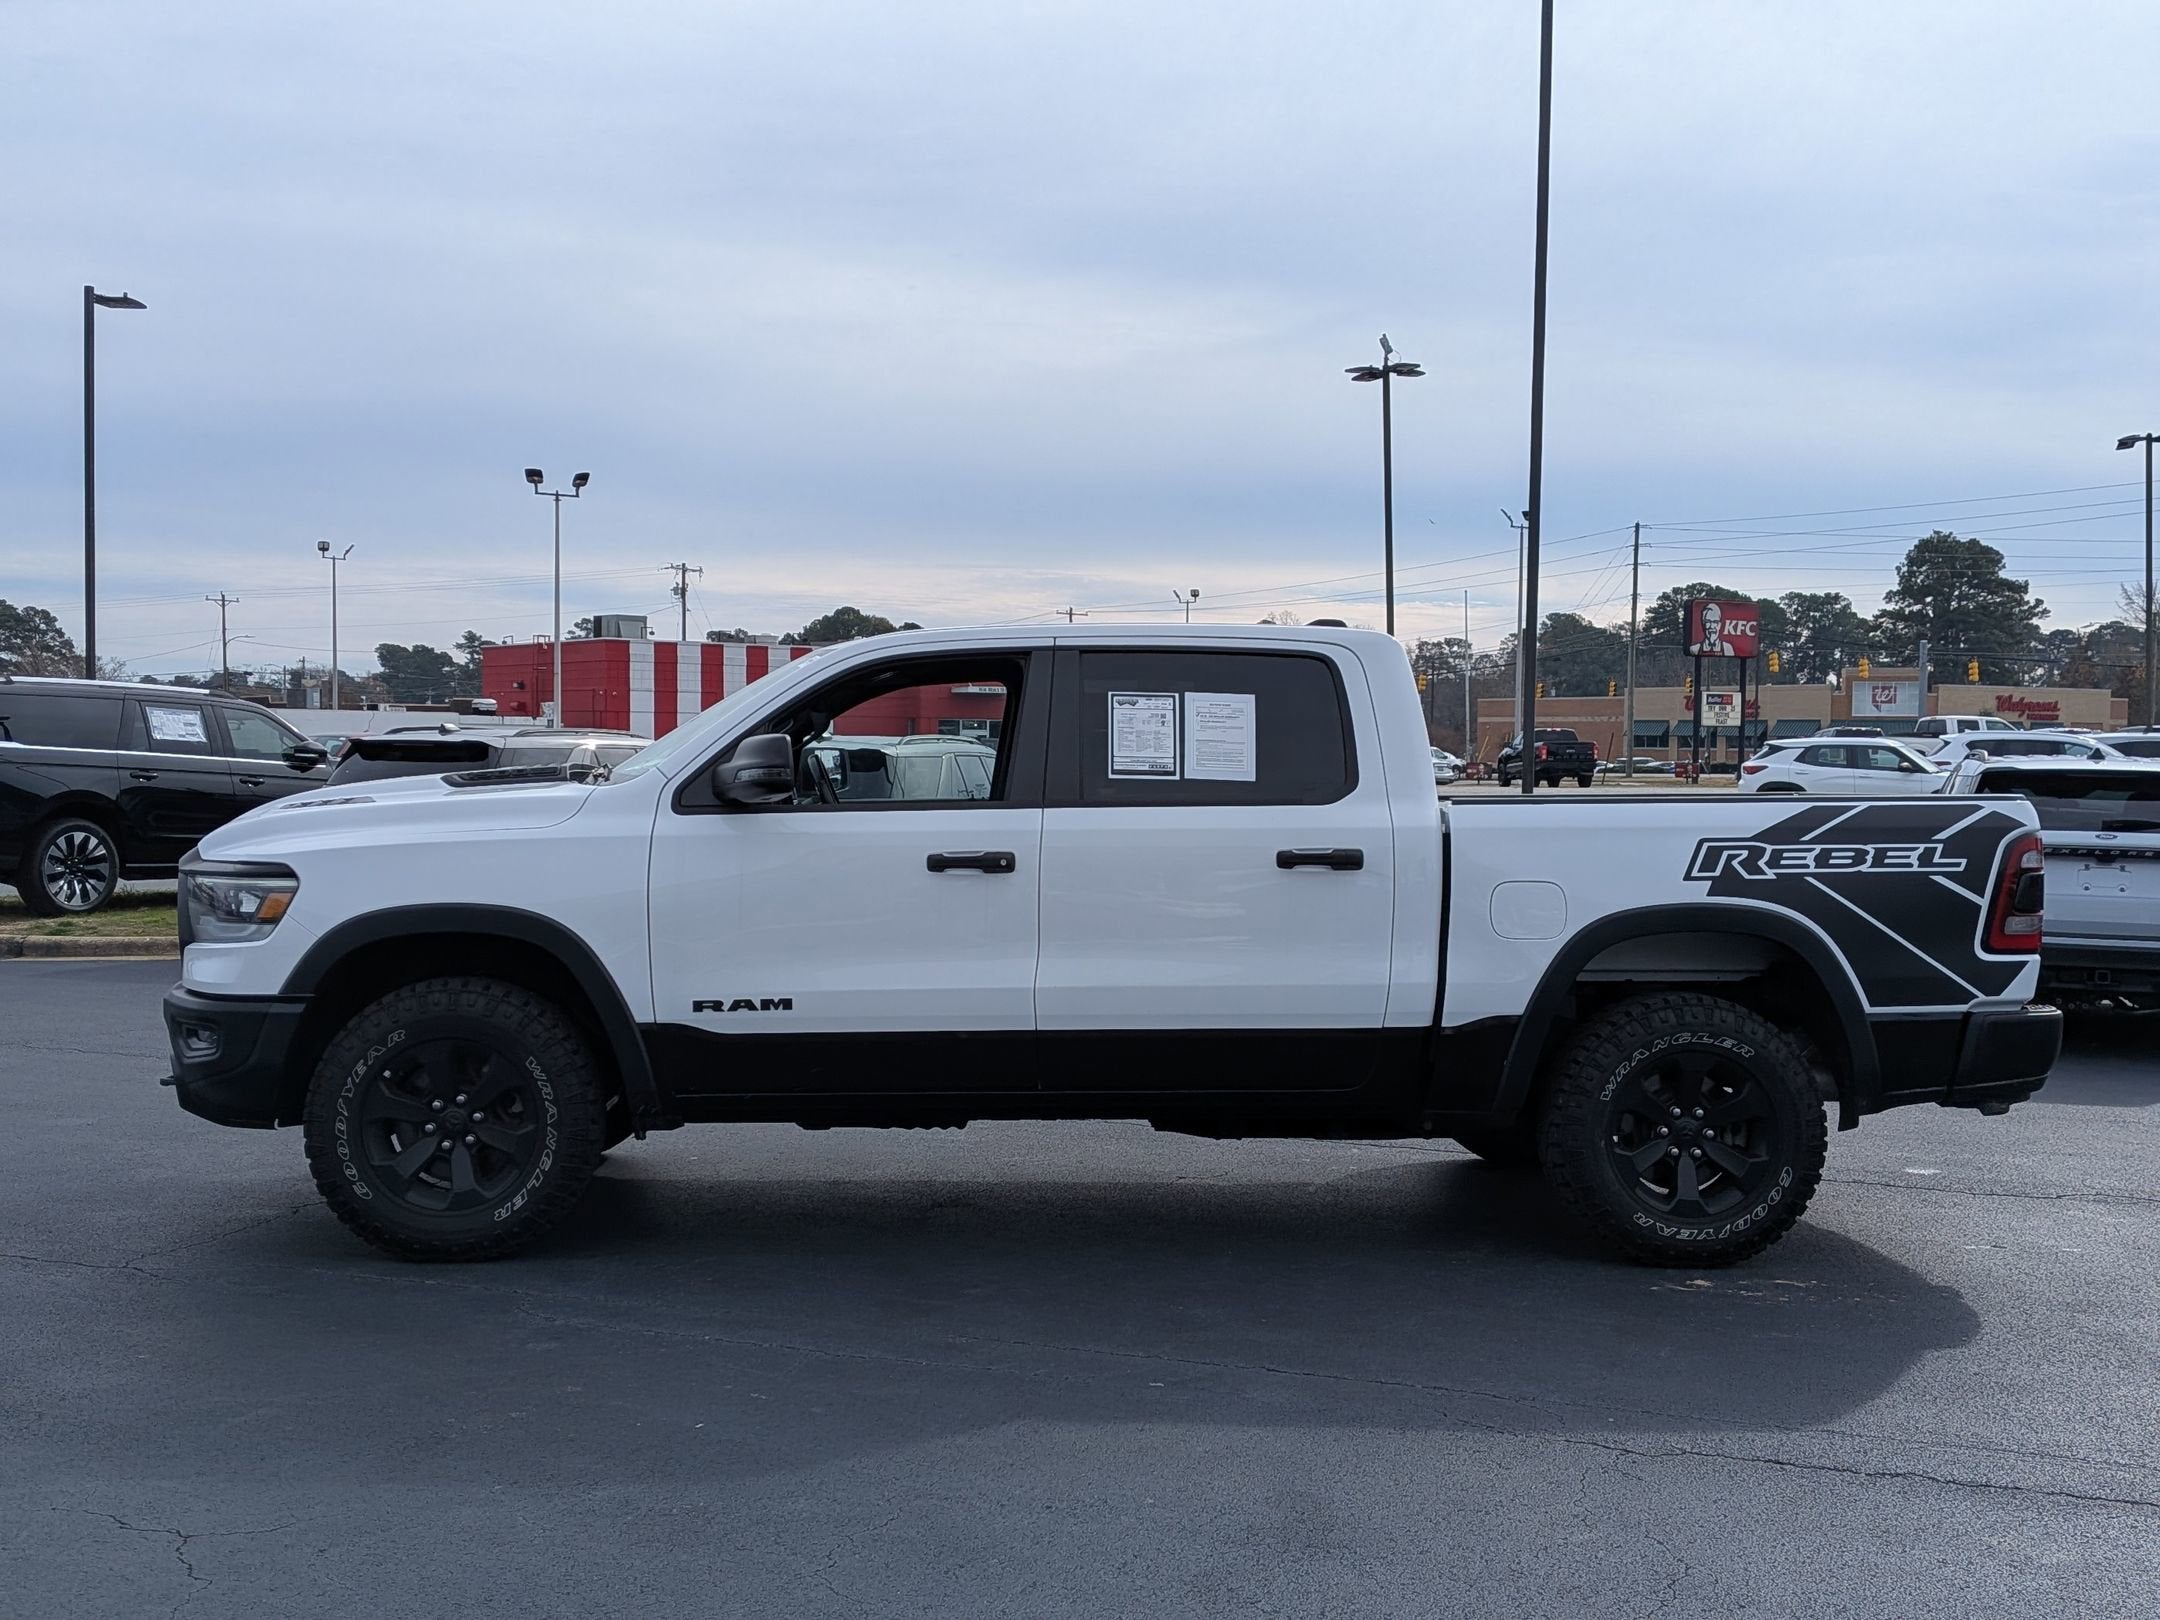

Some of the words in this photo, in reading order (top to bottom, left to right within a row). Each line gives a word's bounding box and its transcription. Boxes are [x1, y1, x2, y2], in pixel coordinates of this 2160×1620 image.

[1723, 620, 1757, 636] KFC
[1688, 841, 1968, 880] REBEL
[692, 998, 793, 1012] RAM
[1600, 1032, 1755, 1101] WRANGLER
[335, 1029, 405, 1200] GOODYEAR
[494, 1056, 558, 1221] WRANGLER
[1633, 1166, 1793, 1240] GOODYEAR
